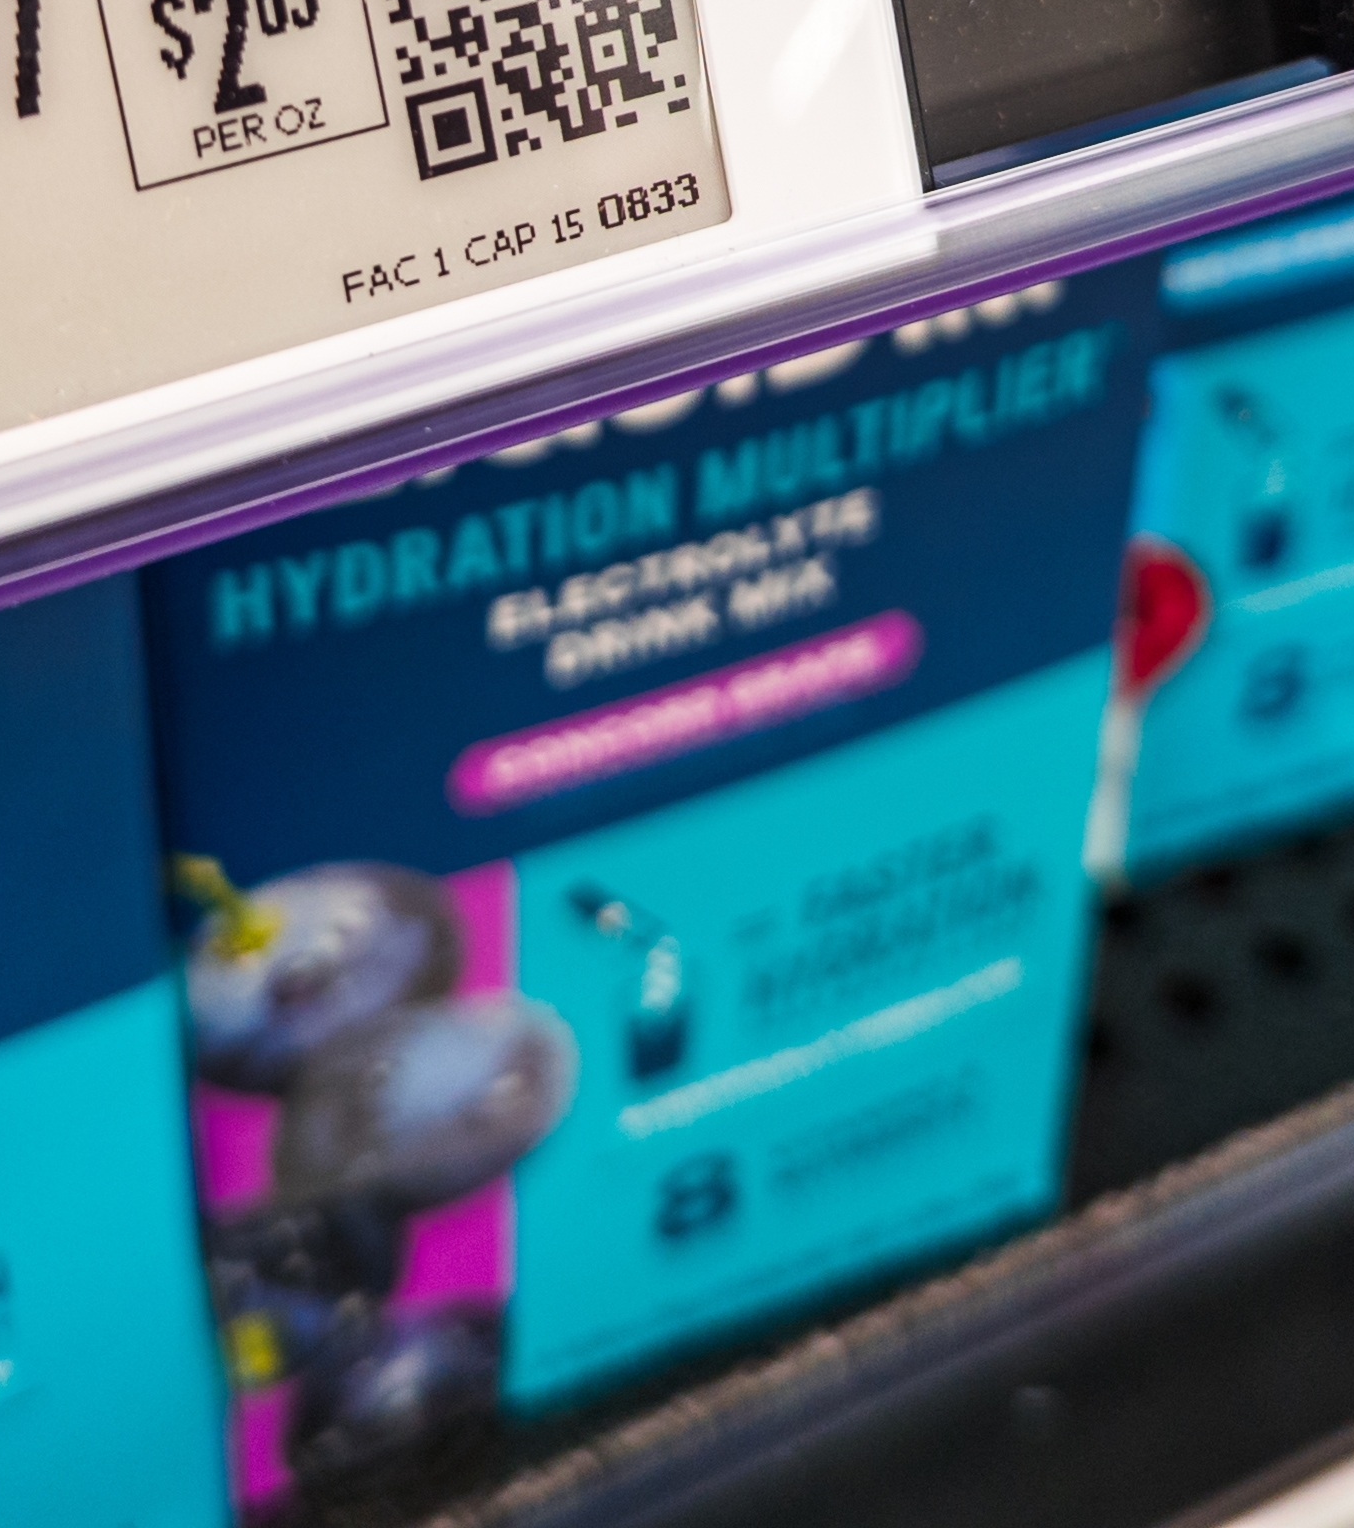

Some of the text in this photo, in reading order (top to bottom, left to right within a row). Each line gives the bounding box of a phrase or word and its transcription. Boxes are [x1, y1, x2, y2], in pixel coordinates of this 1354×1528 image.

[193, 98, 327, 159] PER OZ
[342, 172, 702, 303] FAC 1 CAP 15 0833
[211, 462, 679, 648] HYDRATION
[695, 325, 1107, 522] MULTIPLIER
